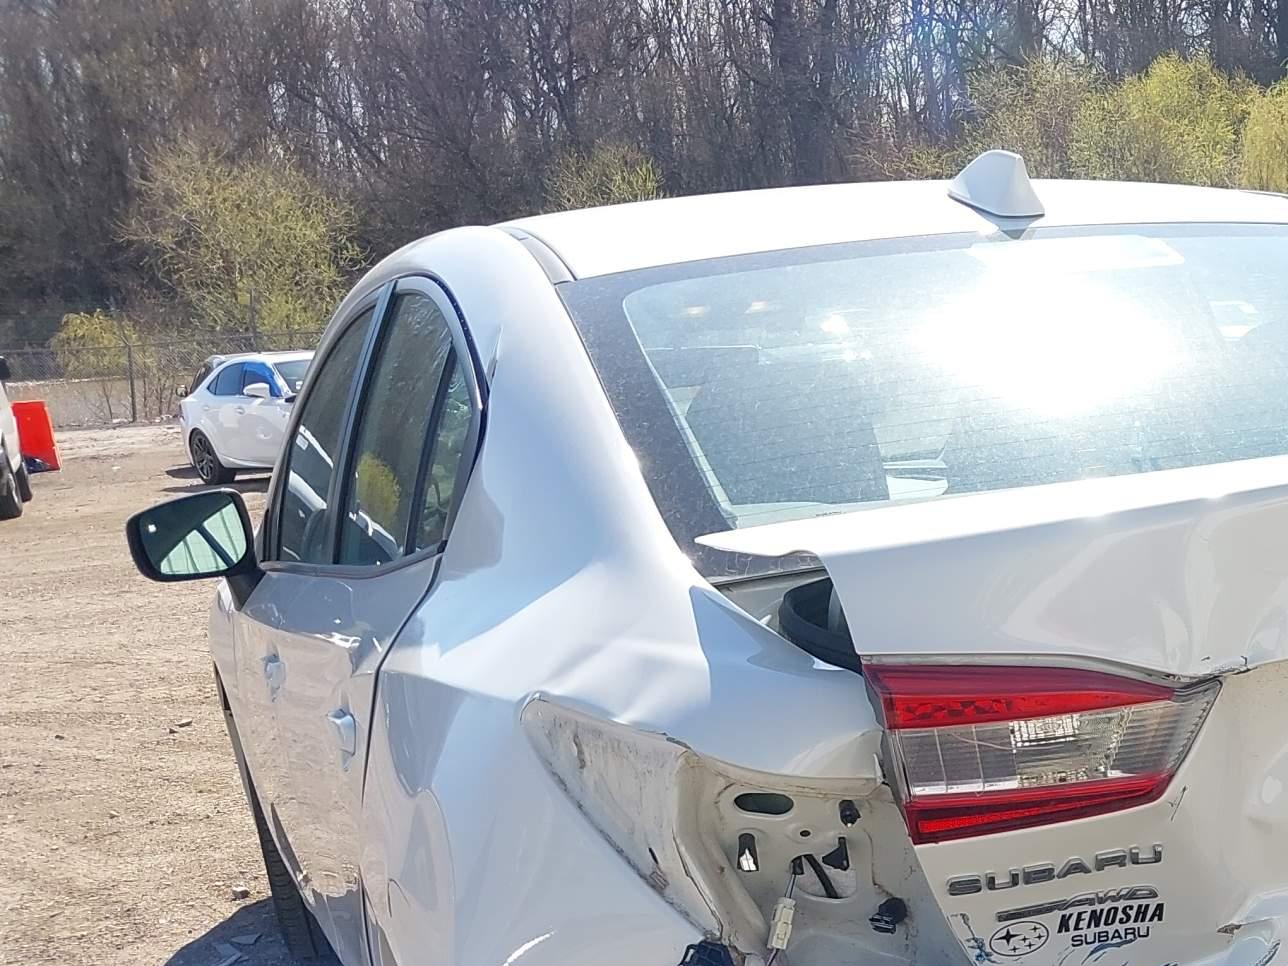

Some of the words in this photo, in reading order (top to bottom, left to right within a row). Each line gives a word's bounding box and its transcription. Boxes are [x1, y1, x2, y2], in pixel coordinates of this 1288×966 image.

[946, 843, 1164, 896] SUBARU
[1058, 885, 1159, 911] AWD
[1057, 902, 1165, 934] KENOSHA
[1071, 925, 1151, 948] SUBARU
